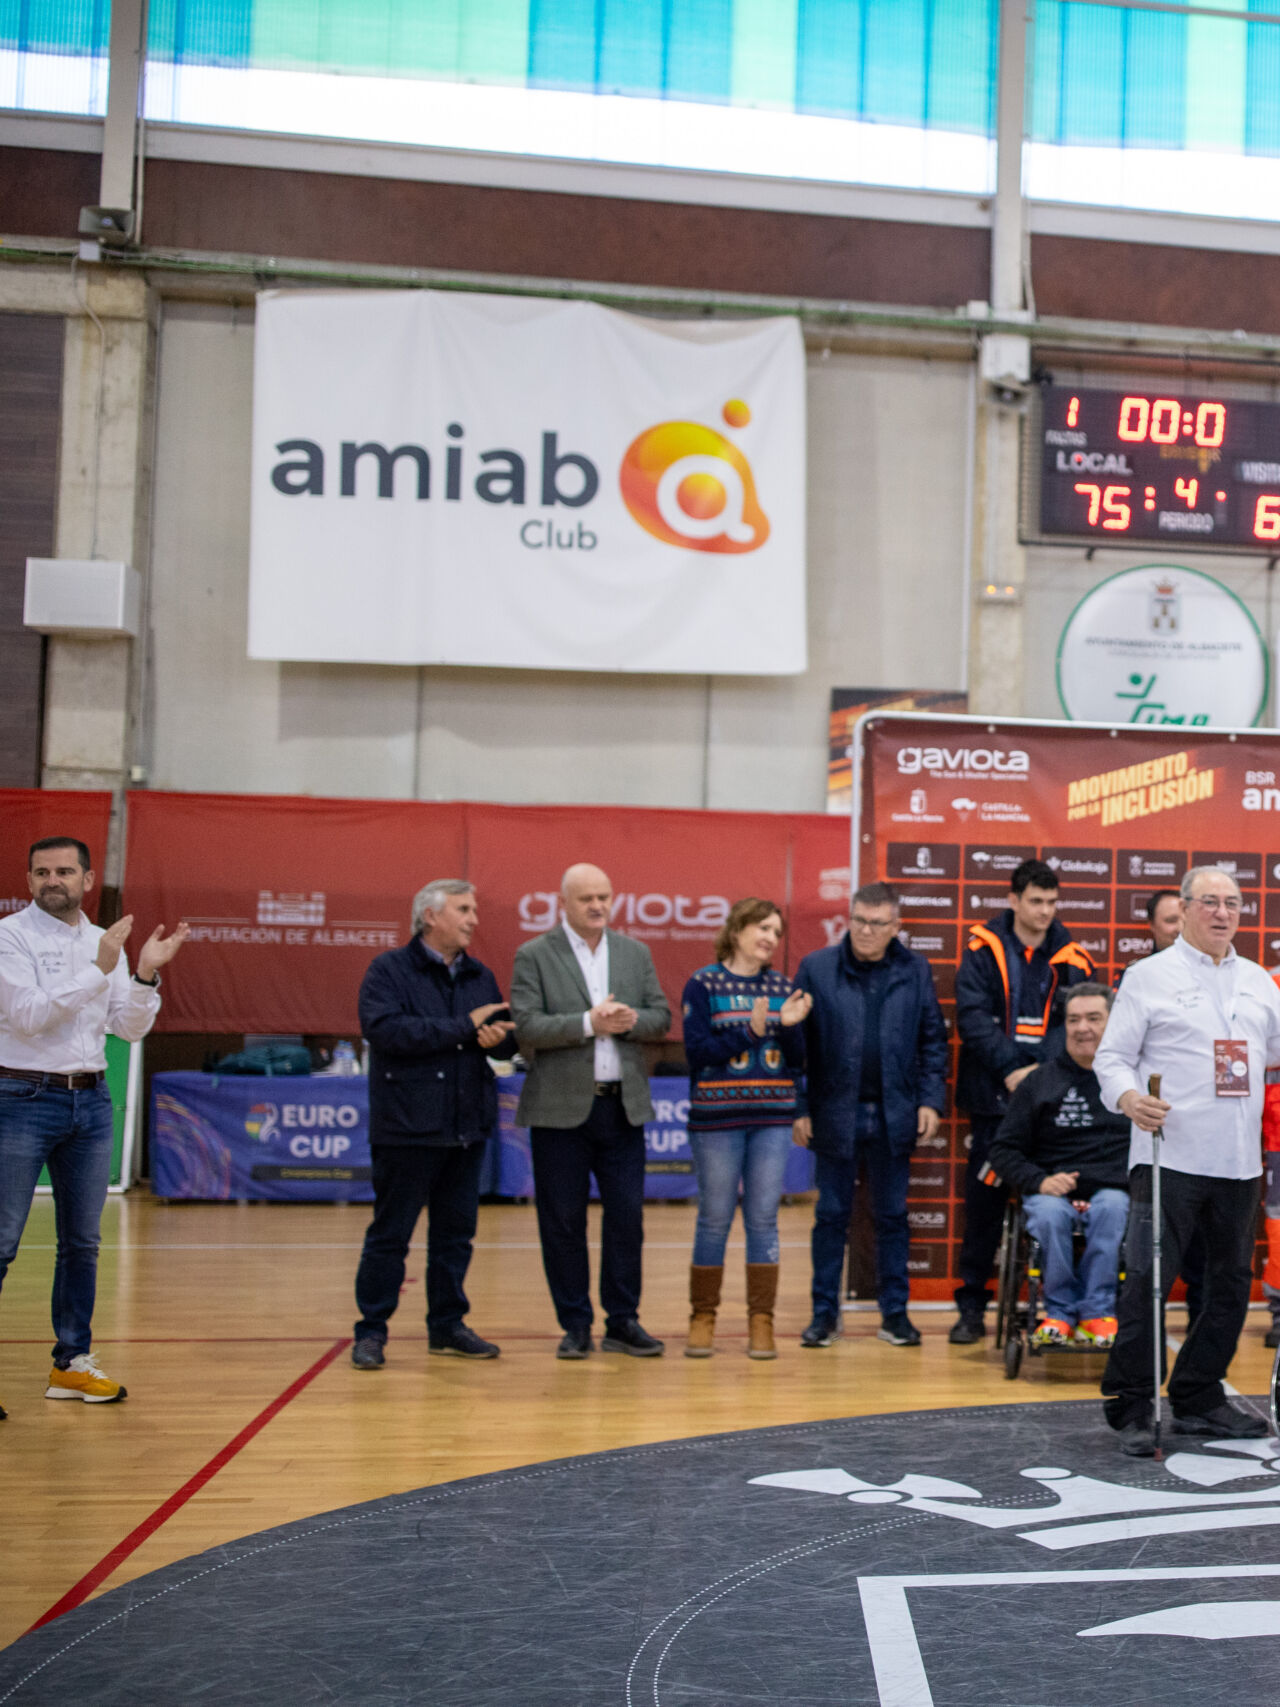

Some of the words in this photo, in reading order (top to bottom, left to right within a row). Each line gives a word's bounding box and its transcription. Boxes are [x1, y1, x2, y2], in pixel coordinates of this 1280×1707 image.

[1118, 396, 1226, 447] 00:0
[270, 421, 600, 508] amiab
[1056, 451, 1133, 474] LOCAL
[1074, 483, 1132, 530] 75
[520, 519, 597, 551] Club
[897, 747, 1029, 774] gaviota
[1068, 751, 1188, 807] MOVIMIENTO
[1245, 771, 1275, 786] BSR
[1102, 767, 1214, 827] INCLUSIÓN
[285, 929, 309, 945] DE
[312, 930, 399, 948] ALBACETE
[282, 1104, 359, 1128] EURO
[290, 1135, 352, 1158] CUP
[645, 1129, 688, 1152] UP
